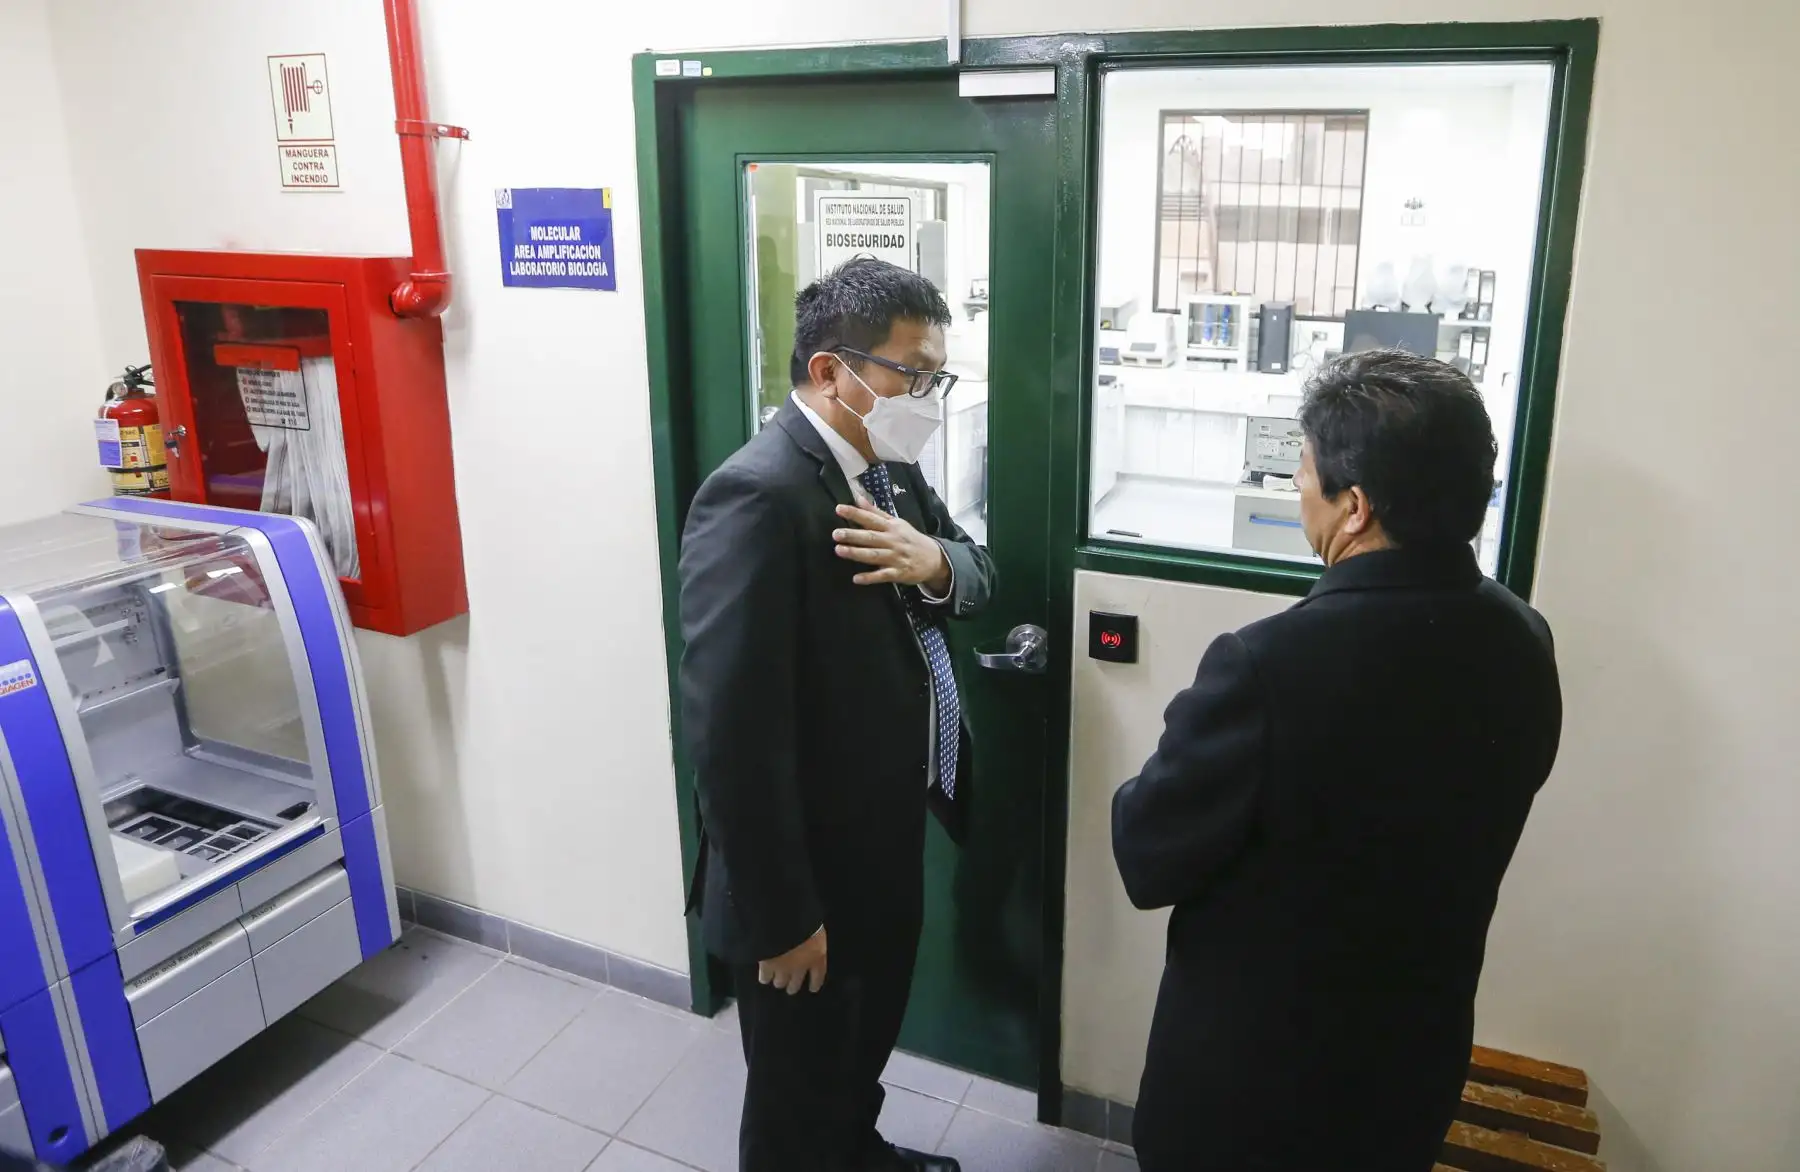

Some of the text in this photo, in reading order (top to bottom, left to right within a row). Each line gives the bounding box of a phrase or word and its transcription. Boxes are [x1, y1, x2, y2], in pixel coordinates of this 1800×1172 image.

[285, 149, 329, 158] MANGUERA
[292, 161, 325, 170] CONTRA
[291, 174, 329, 183] INCENDIO
[825, 203, 905, 215] INSTITUTO NACIONAL DE SALUD
[530, 226, 581, 241] MOLECULAR
[826, 233, 905, 248] BIOSEGURIDAD
[514, 244, 536, 259] AREA
[509, 261, 566, 276] LABORATORIO
